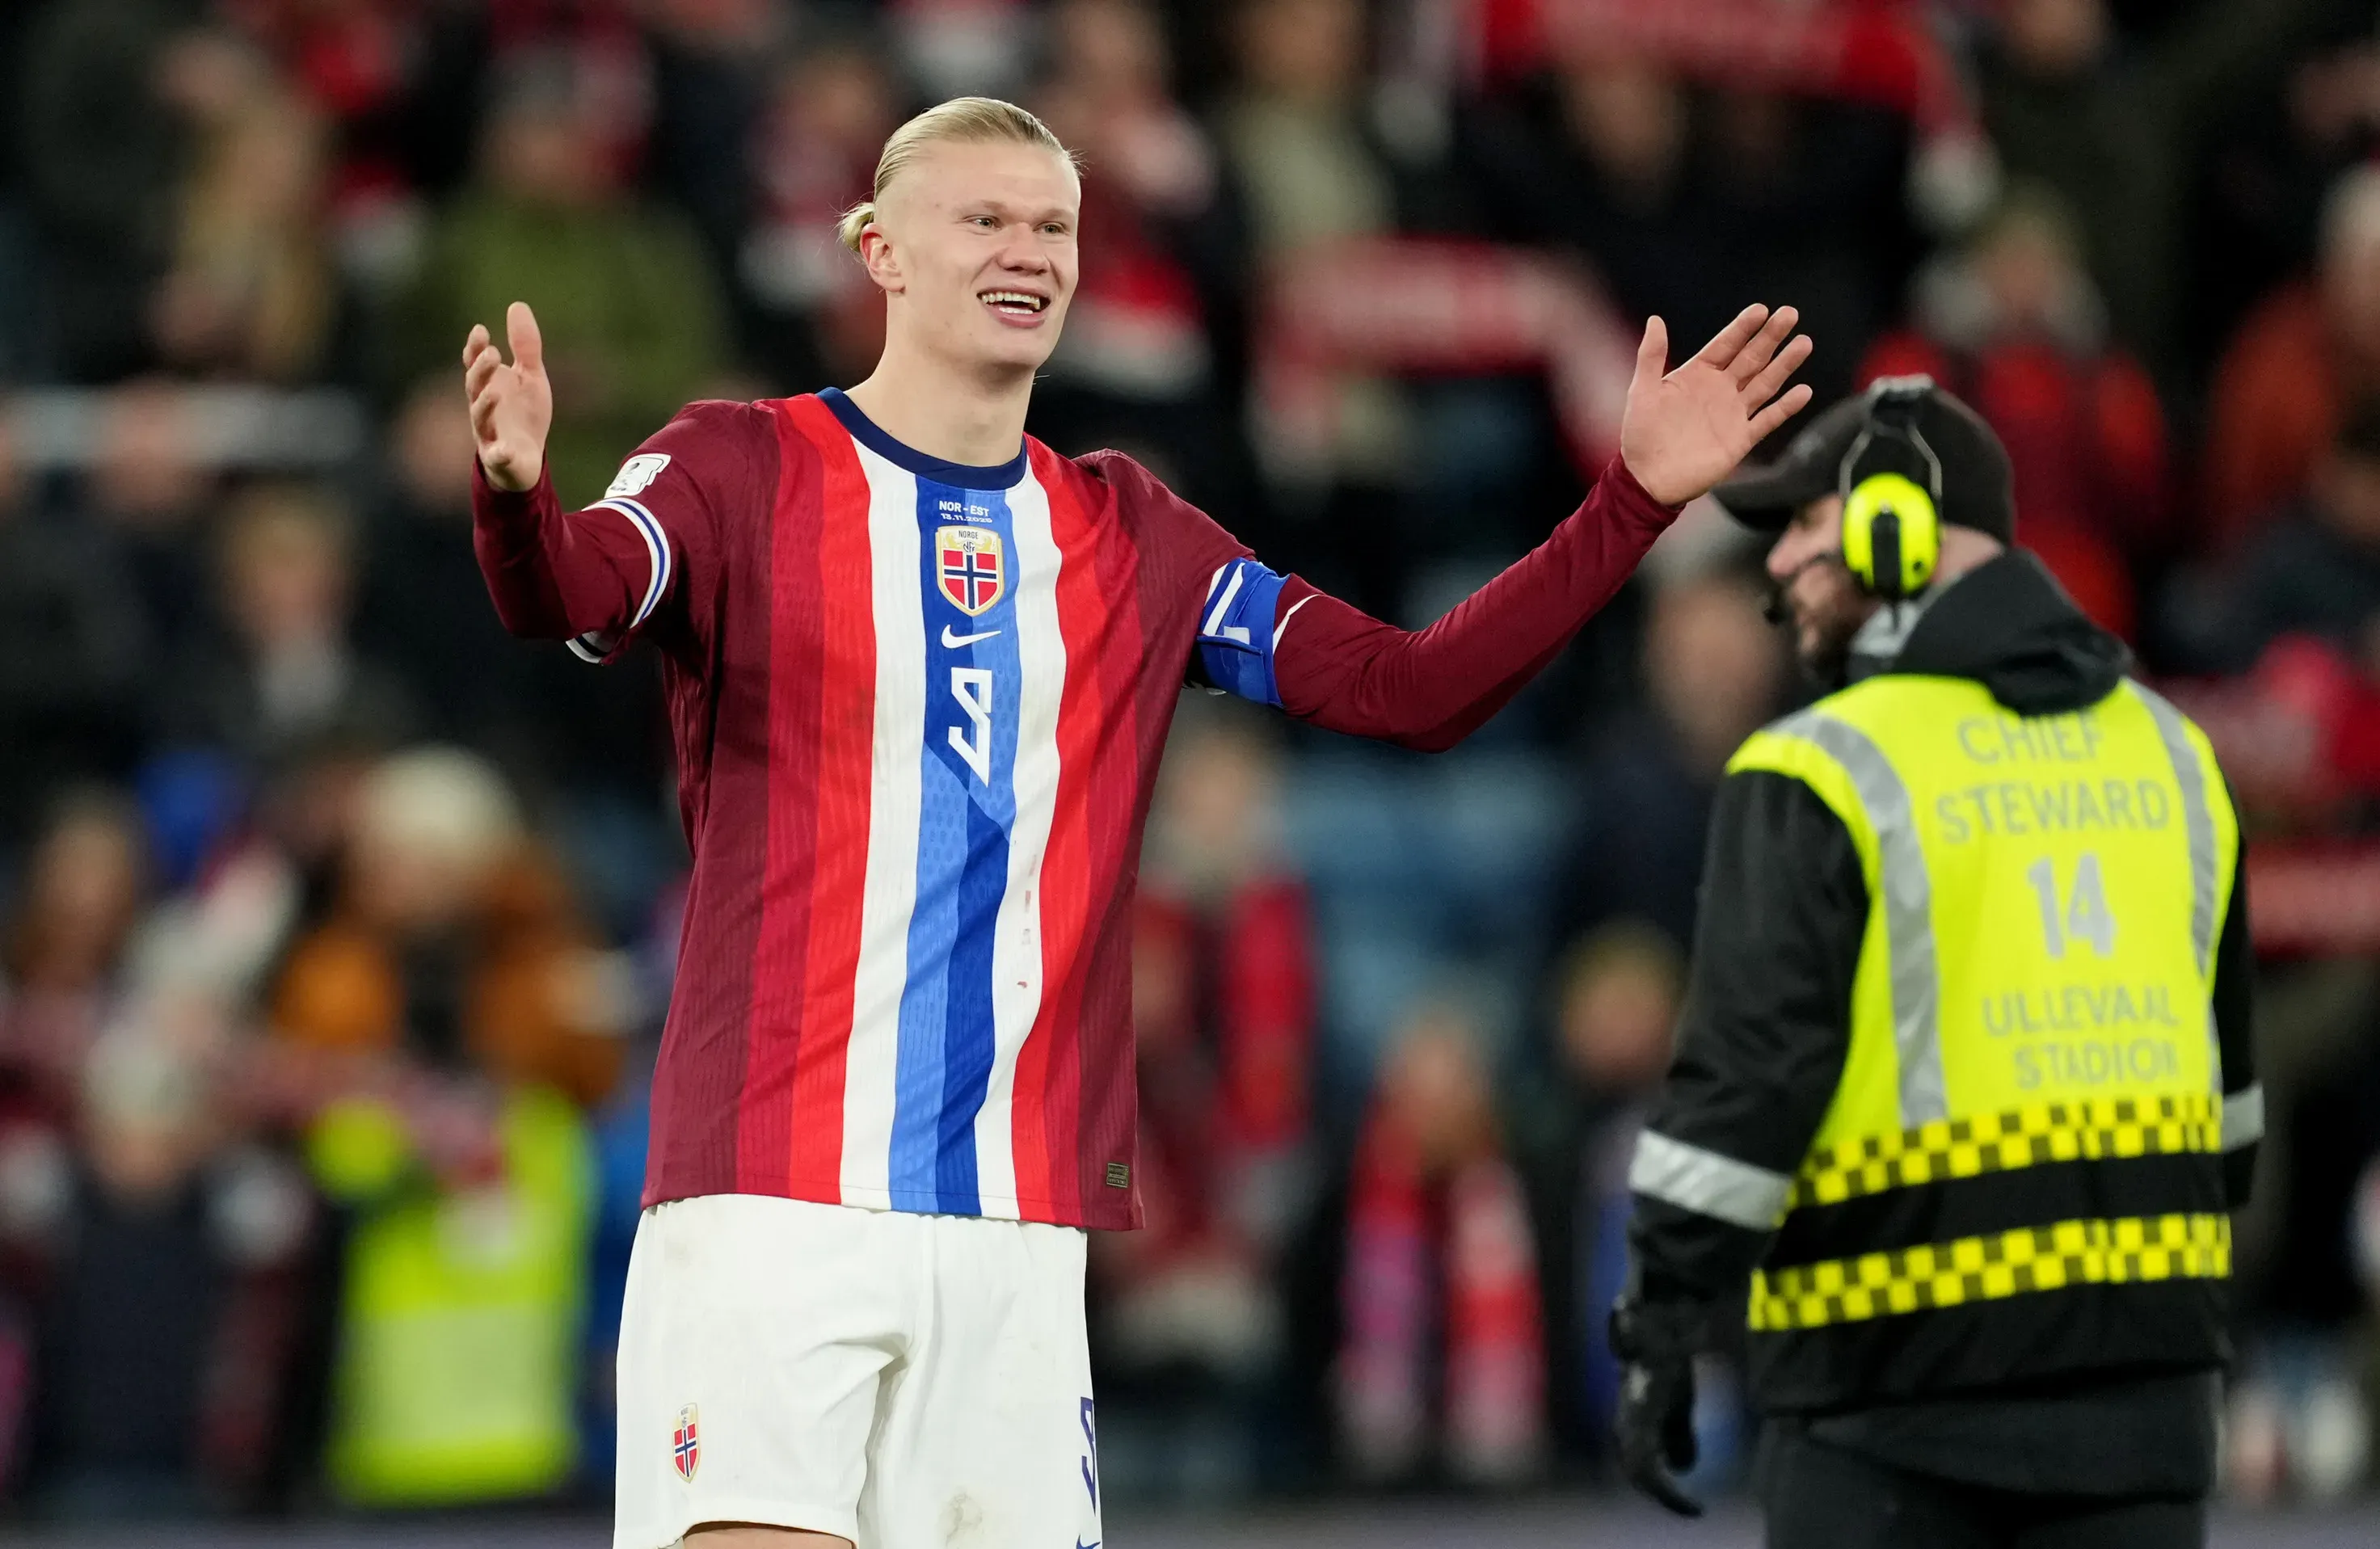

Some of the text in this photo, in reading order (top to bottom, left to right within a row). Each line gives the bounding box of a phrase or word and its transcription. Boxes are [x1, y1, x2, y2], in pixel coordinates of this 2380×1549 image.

[939, 500, 961, 512] NOR
[971, 505, 989, 516] EST
[941, 513, 992, 523] 13.11.2025
[958, 530, 978, 539] NORGE
[948, 667, 992, 788] 9
[1957, 713, 2104, 764] CHIEF
[1936, 779, 2168, 844] STEWARD
[2028, 852, 2117, 959] 14
